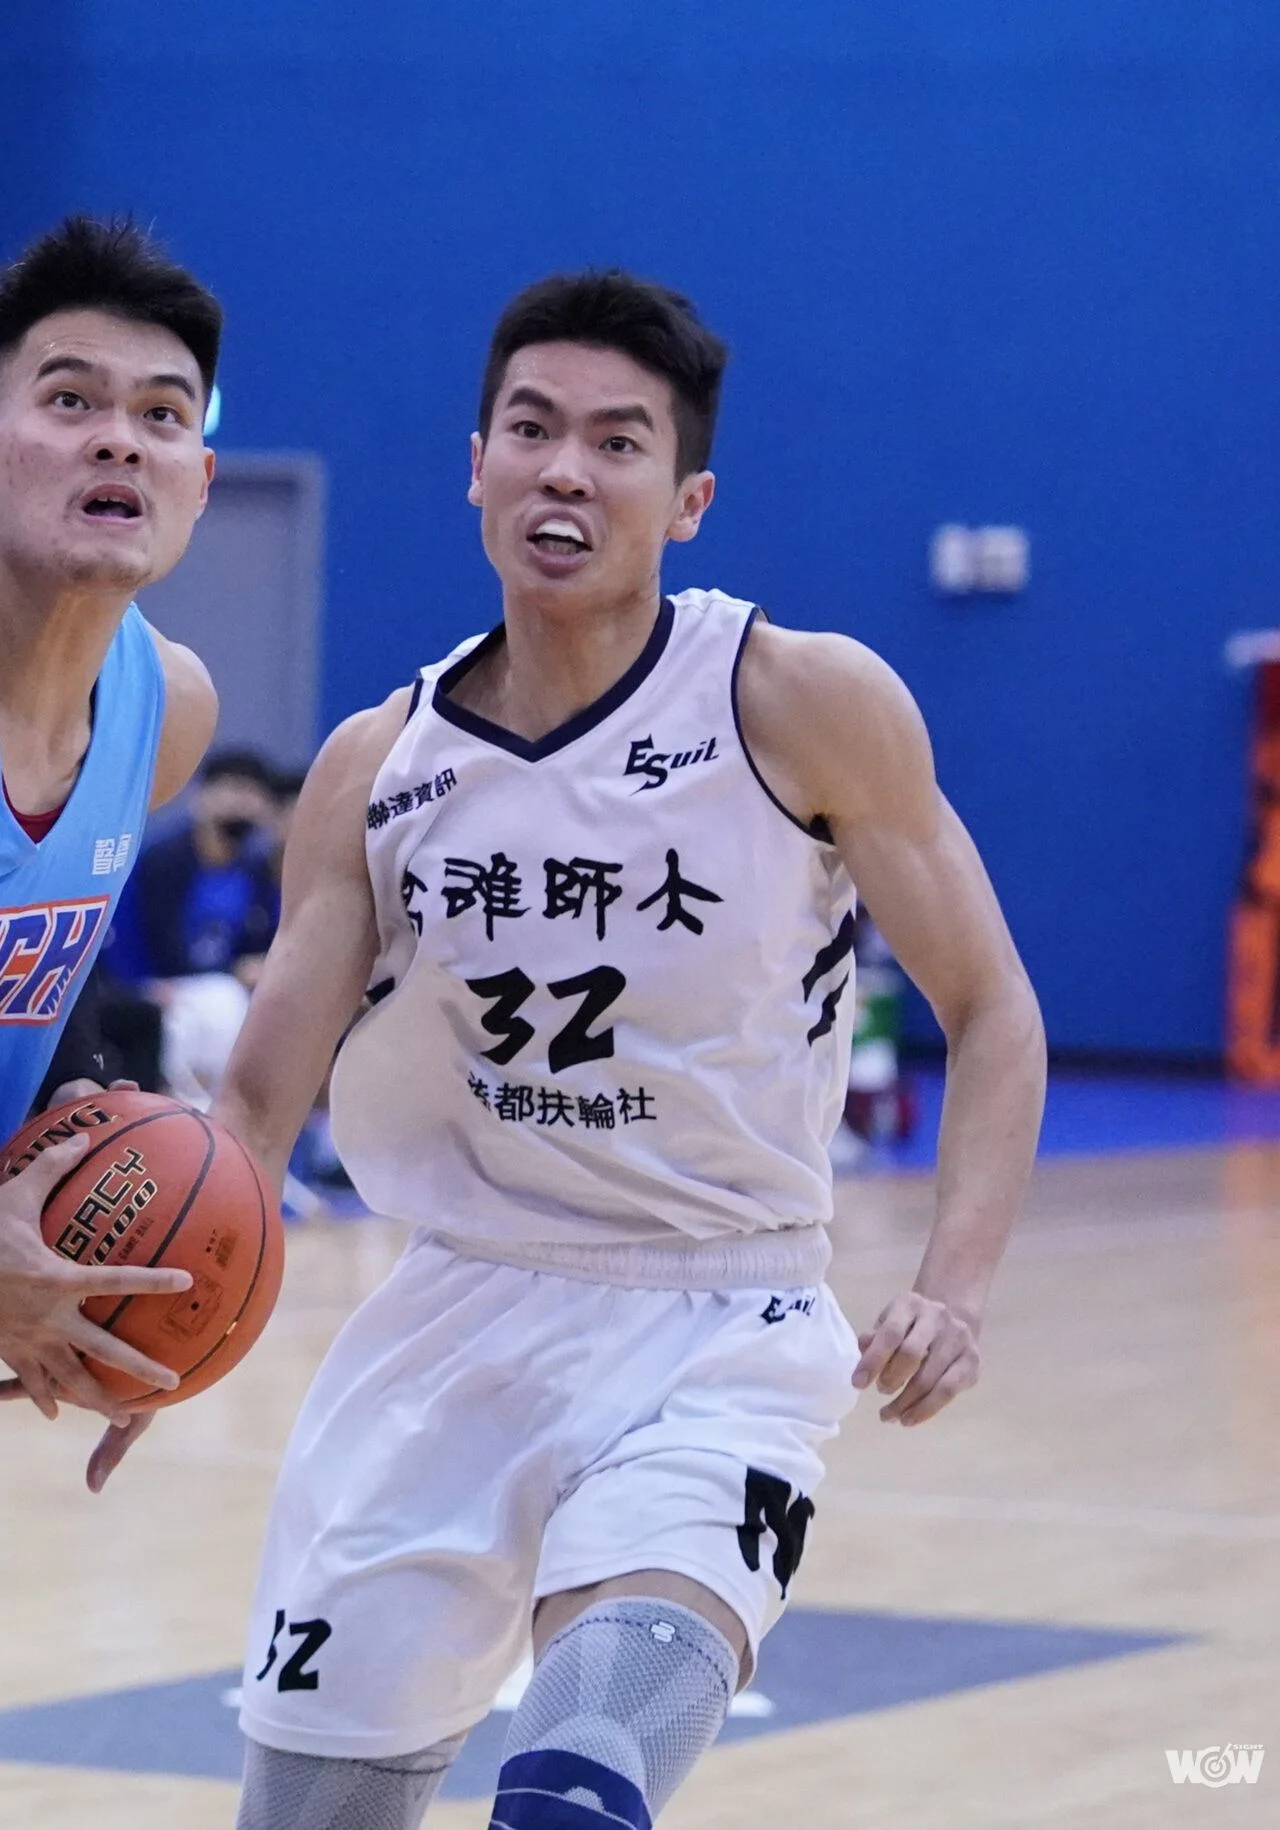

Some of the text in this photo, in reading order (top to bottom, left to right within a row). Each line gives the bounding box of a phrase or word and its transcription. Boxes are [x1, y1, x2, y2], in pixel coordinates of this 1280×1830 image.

[464, 965, 626, 1075] 32
[54, 1147, 146, 1263] GACY
[87, 1178, 158, 1266] 000
